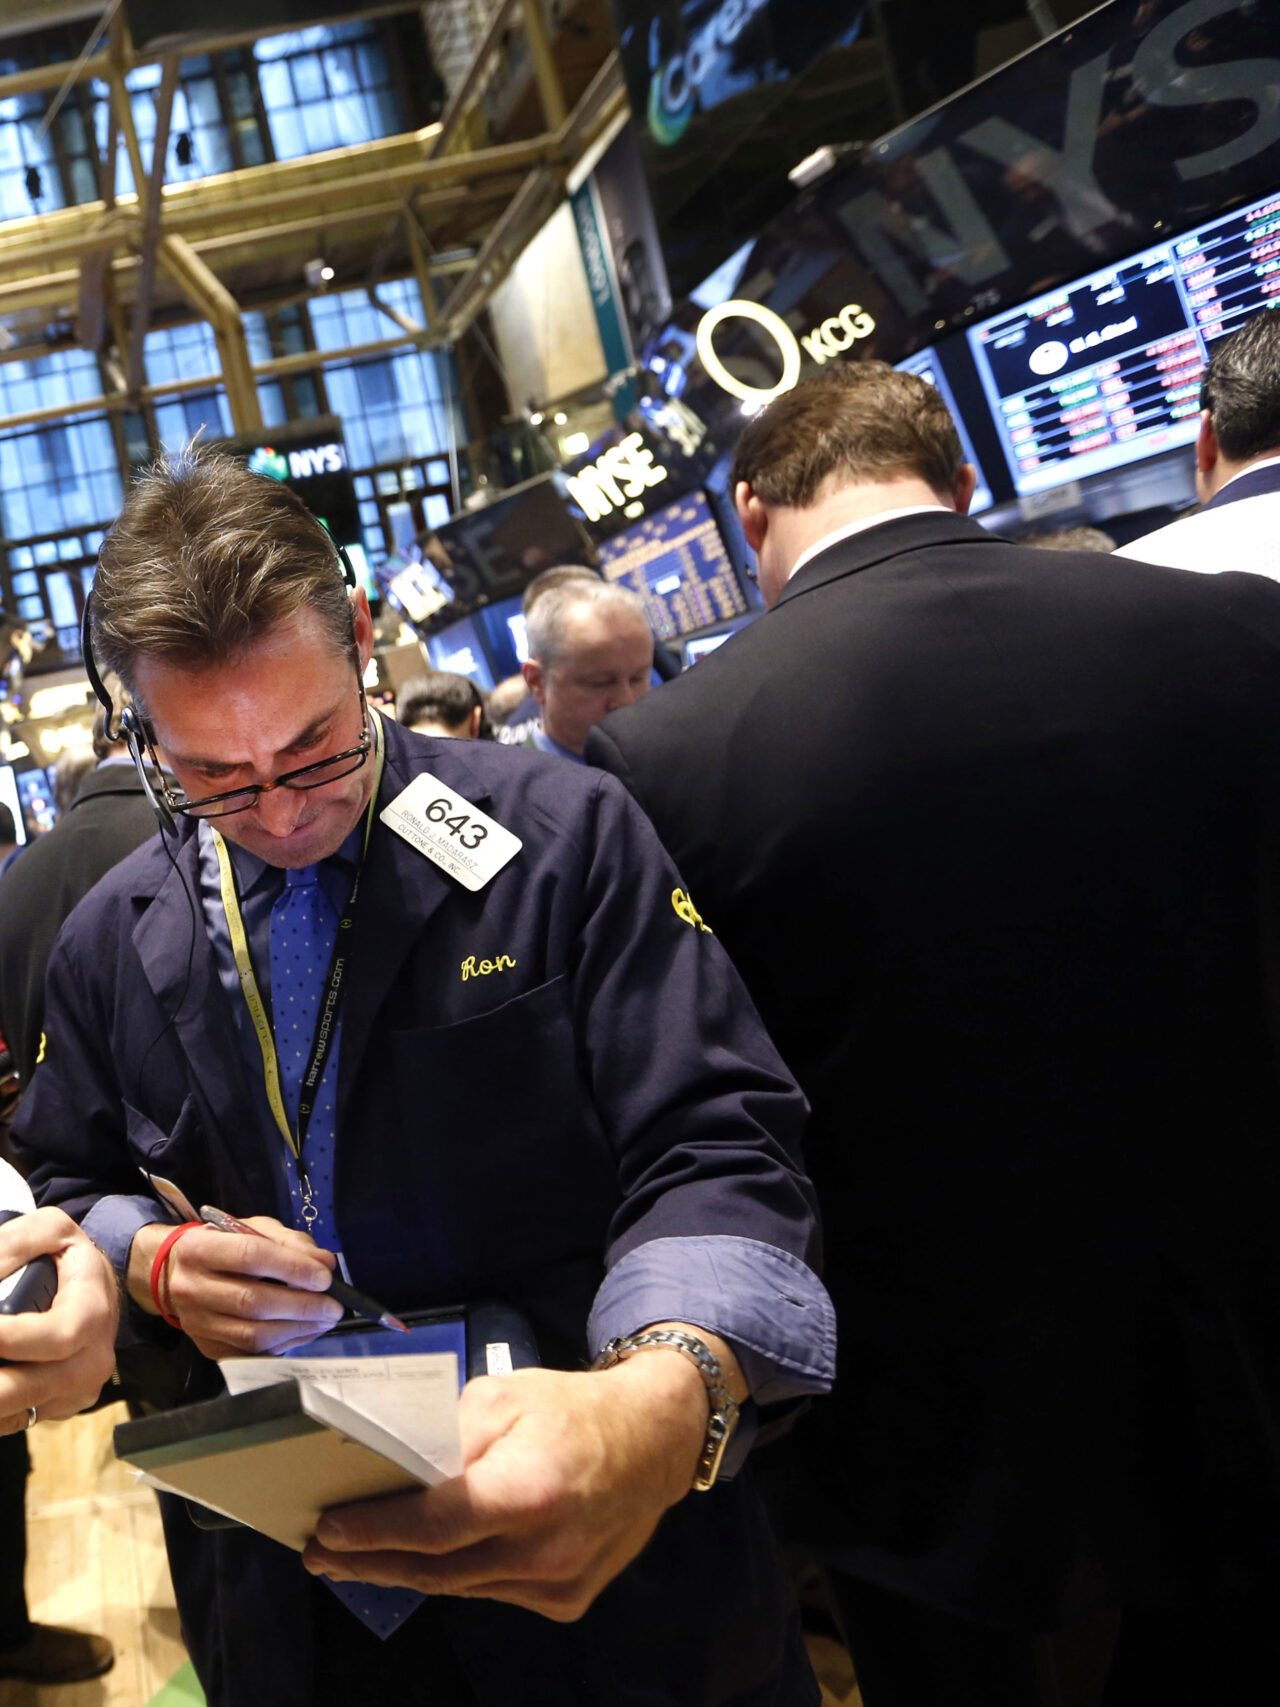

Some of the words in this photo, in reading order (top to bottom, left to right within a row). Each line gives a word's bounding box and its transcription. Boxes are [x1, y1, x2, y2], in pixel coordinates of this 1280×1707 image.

[800, 303, 877, 367] KCG
[288, 443, 342, 479] NYS
[565, 431, 668, 522] NYSE
[397, 824, 428, 850] CUTTONE
[427, 845, 436, 855] &
[401, 810, 431, 834] RONALD
[436, 836, 478, 870] MADARASZ
[425, 798, 489, 850] 643
[461, 954, 516, 981] Ron
[305, 958, 345, 1087] harrowsports.com
